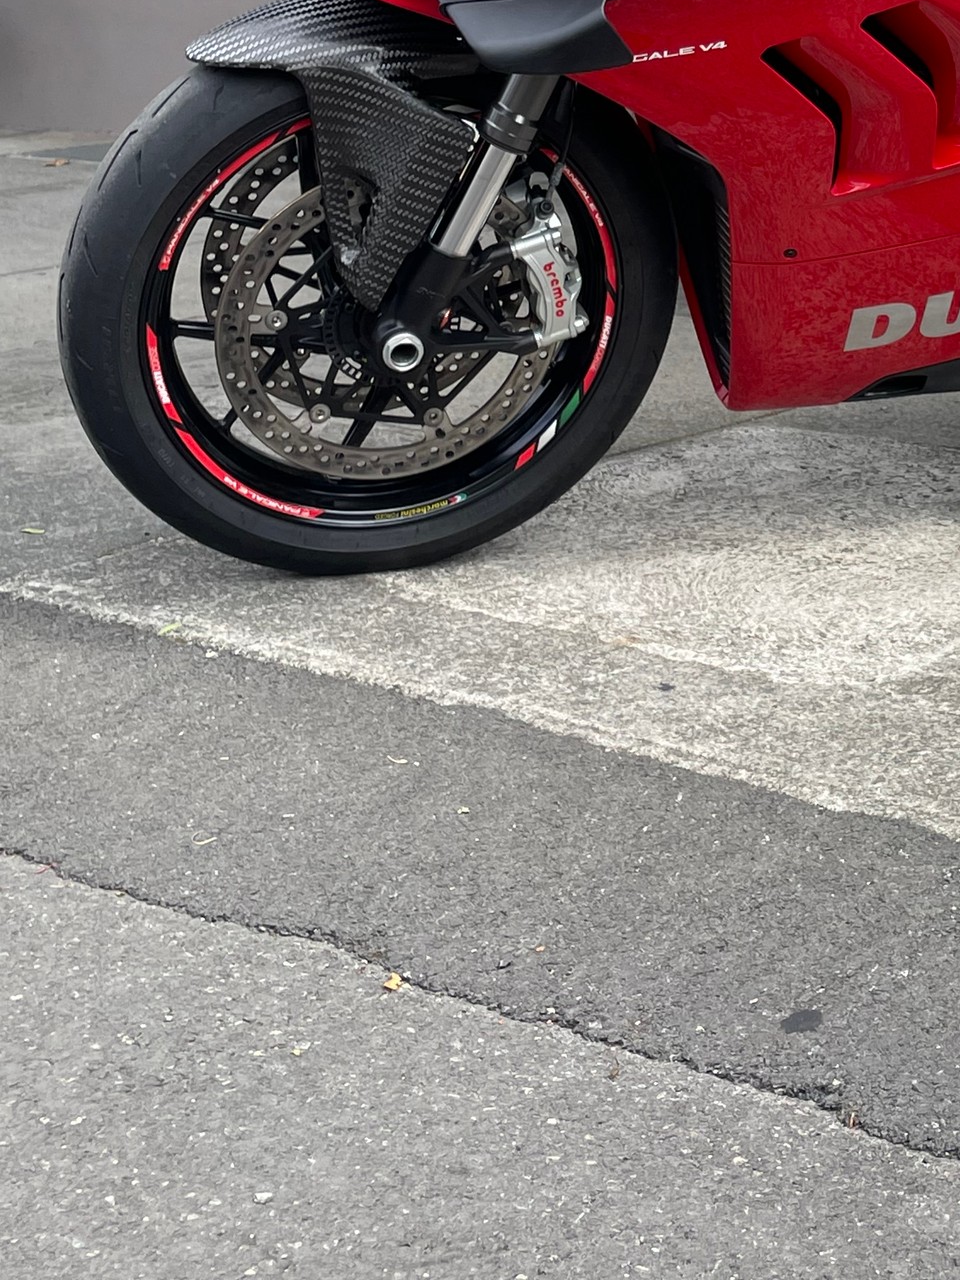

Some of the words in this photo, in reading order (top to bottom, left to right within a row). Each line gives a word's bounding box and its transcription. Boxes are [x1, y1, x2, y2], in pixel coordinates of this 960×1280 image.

[632, 46, 696, 63] GALE
[699, 40, 728, 52] V4
[562, 165, 596, 214] ANIGALE
[543, 261, 565, 318] brembo
[600, 315, 613, 350] DUCATI
